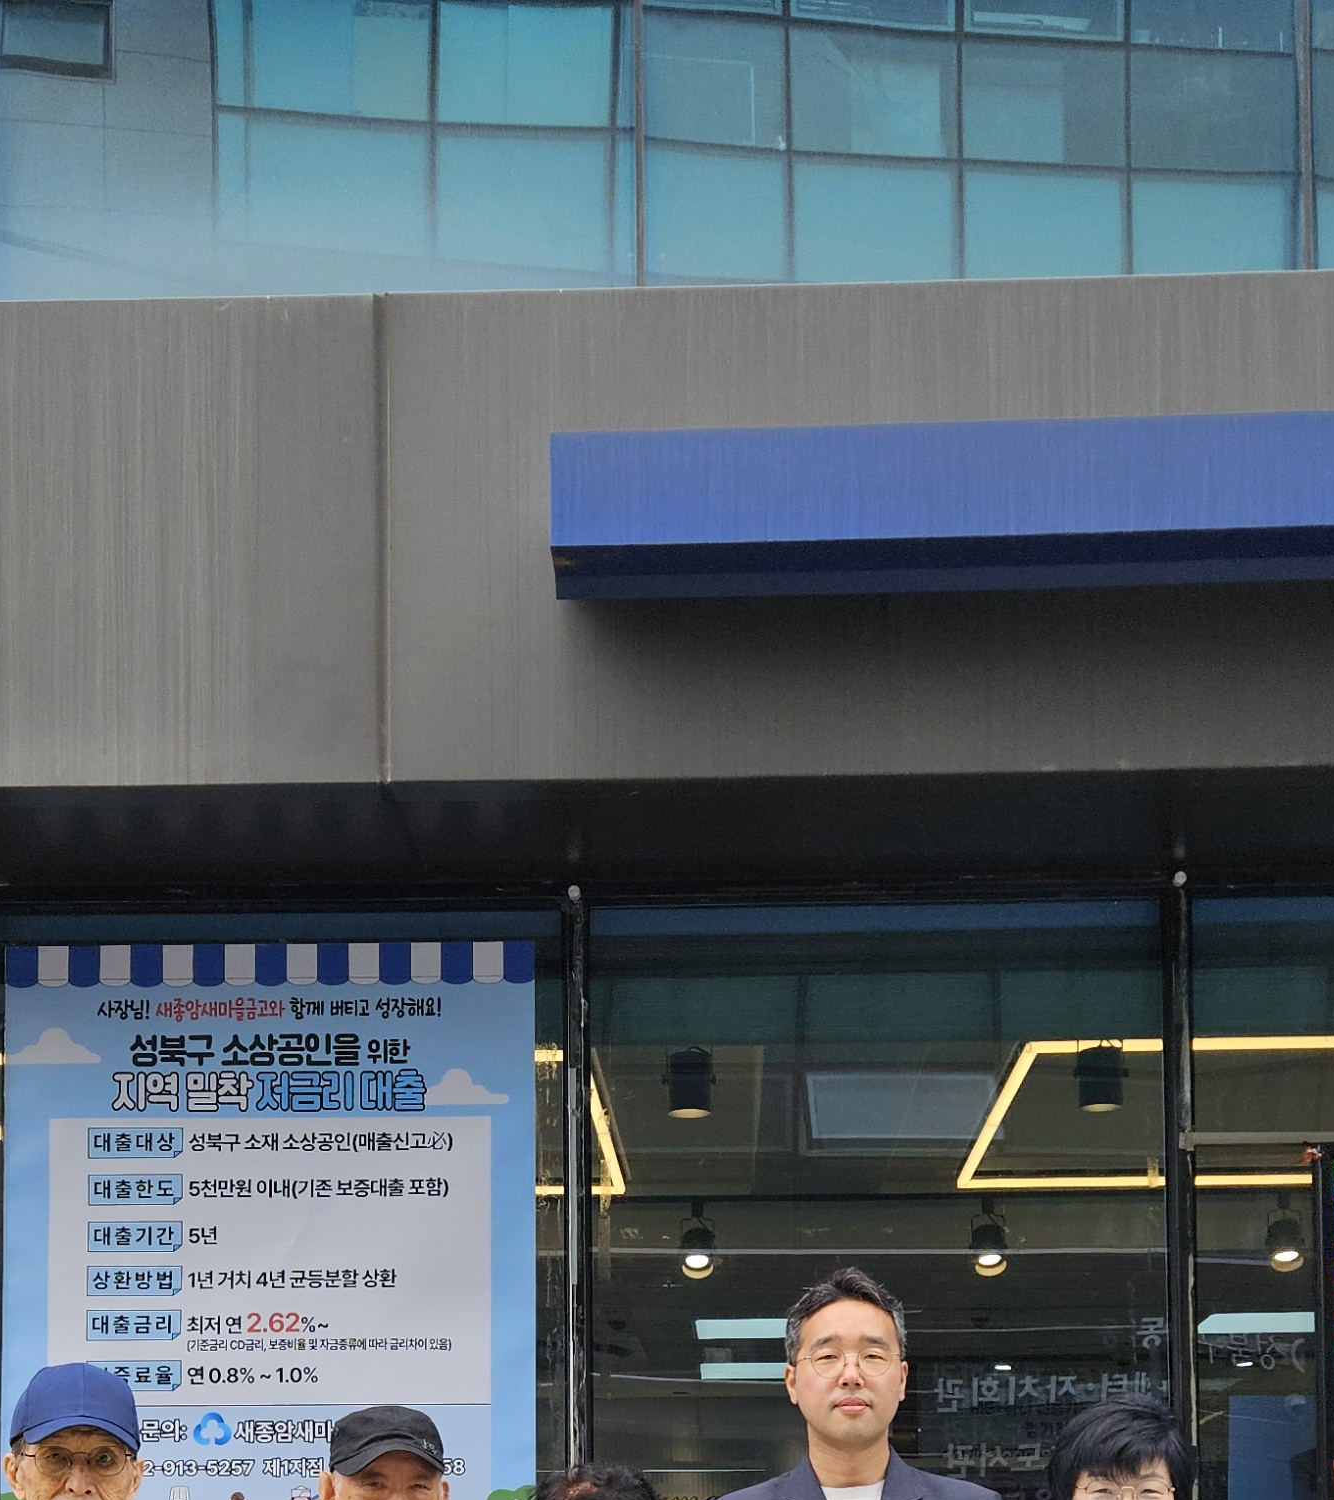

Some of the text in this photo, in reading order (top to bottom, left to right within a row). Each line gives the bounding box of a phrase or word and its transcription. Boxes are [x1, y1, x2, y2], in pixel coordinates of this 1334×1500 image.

[96, 996, 442, 1023] 사장님! 새종암새마을금고와 함께 버티고 성장해요!
[129, 1032, 411, 1068] 성북구 소상공인을 위한
[111, 1068, 426, 1112] 지역 밀착 저금리 대출
[93, 1132, 175, 1153] 대출대상
[189, 1132, 241, 1153] 성북구
[243, 1132, 279, 1152] 소재
[93, 1177, 450, 1200] 대출한도 5천만원 이내(기존 보증대출 포함)
[93, 1225, 217, 1246] 대출기간 5년
[92, 1268, 397, 1290] 상환방법 1년 거치 4년 균등분할 상환
[92, 1312, 329, 1335] 대출금리 최저 연 2.62%~
[105, 1366, 173, 1385] 증료율
[187, 1366, 205, 1386] 연
[208, 1367, 255, 1384] 0.8%
[275, 1366, 319, 1384] 1.0%
[234, 1420, 333, 1444] 새종암새마
[143, 1459, 255, 1477] 2-913-5257
